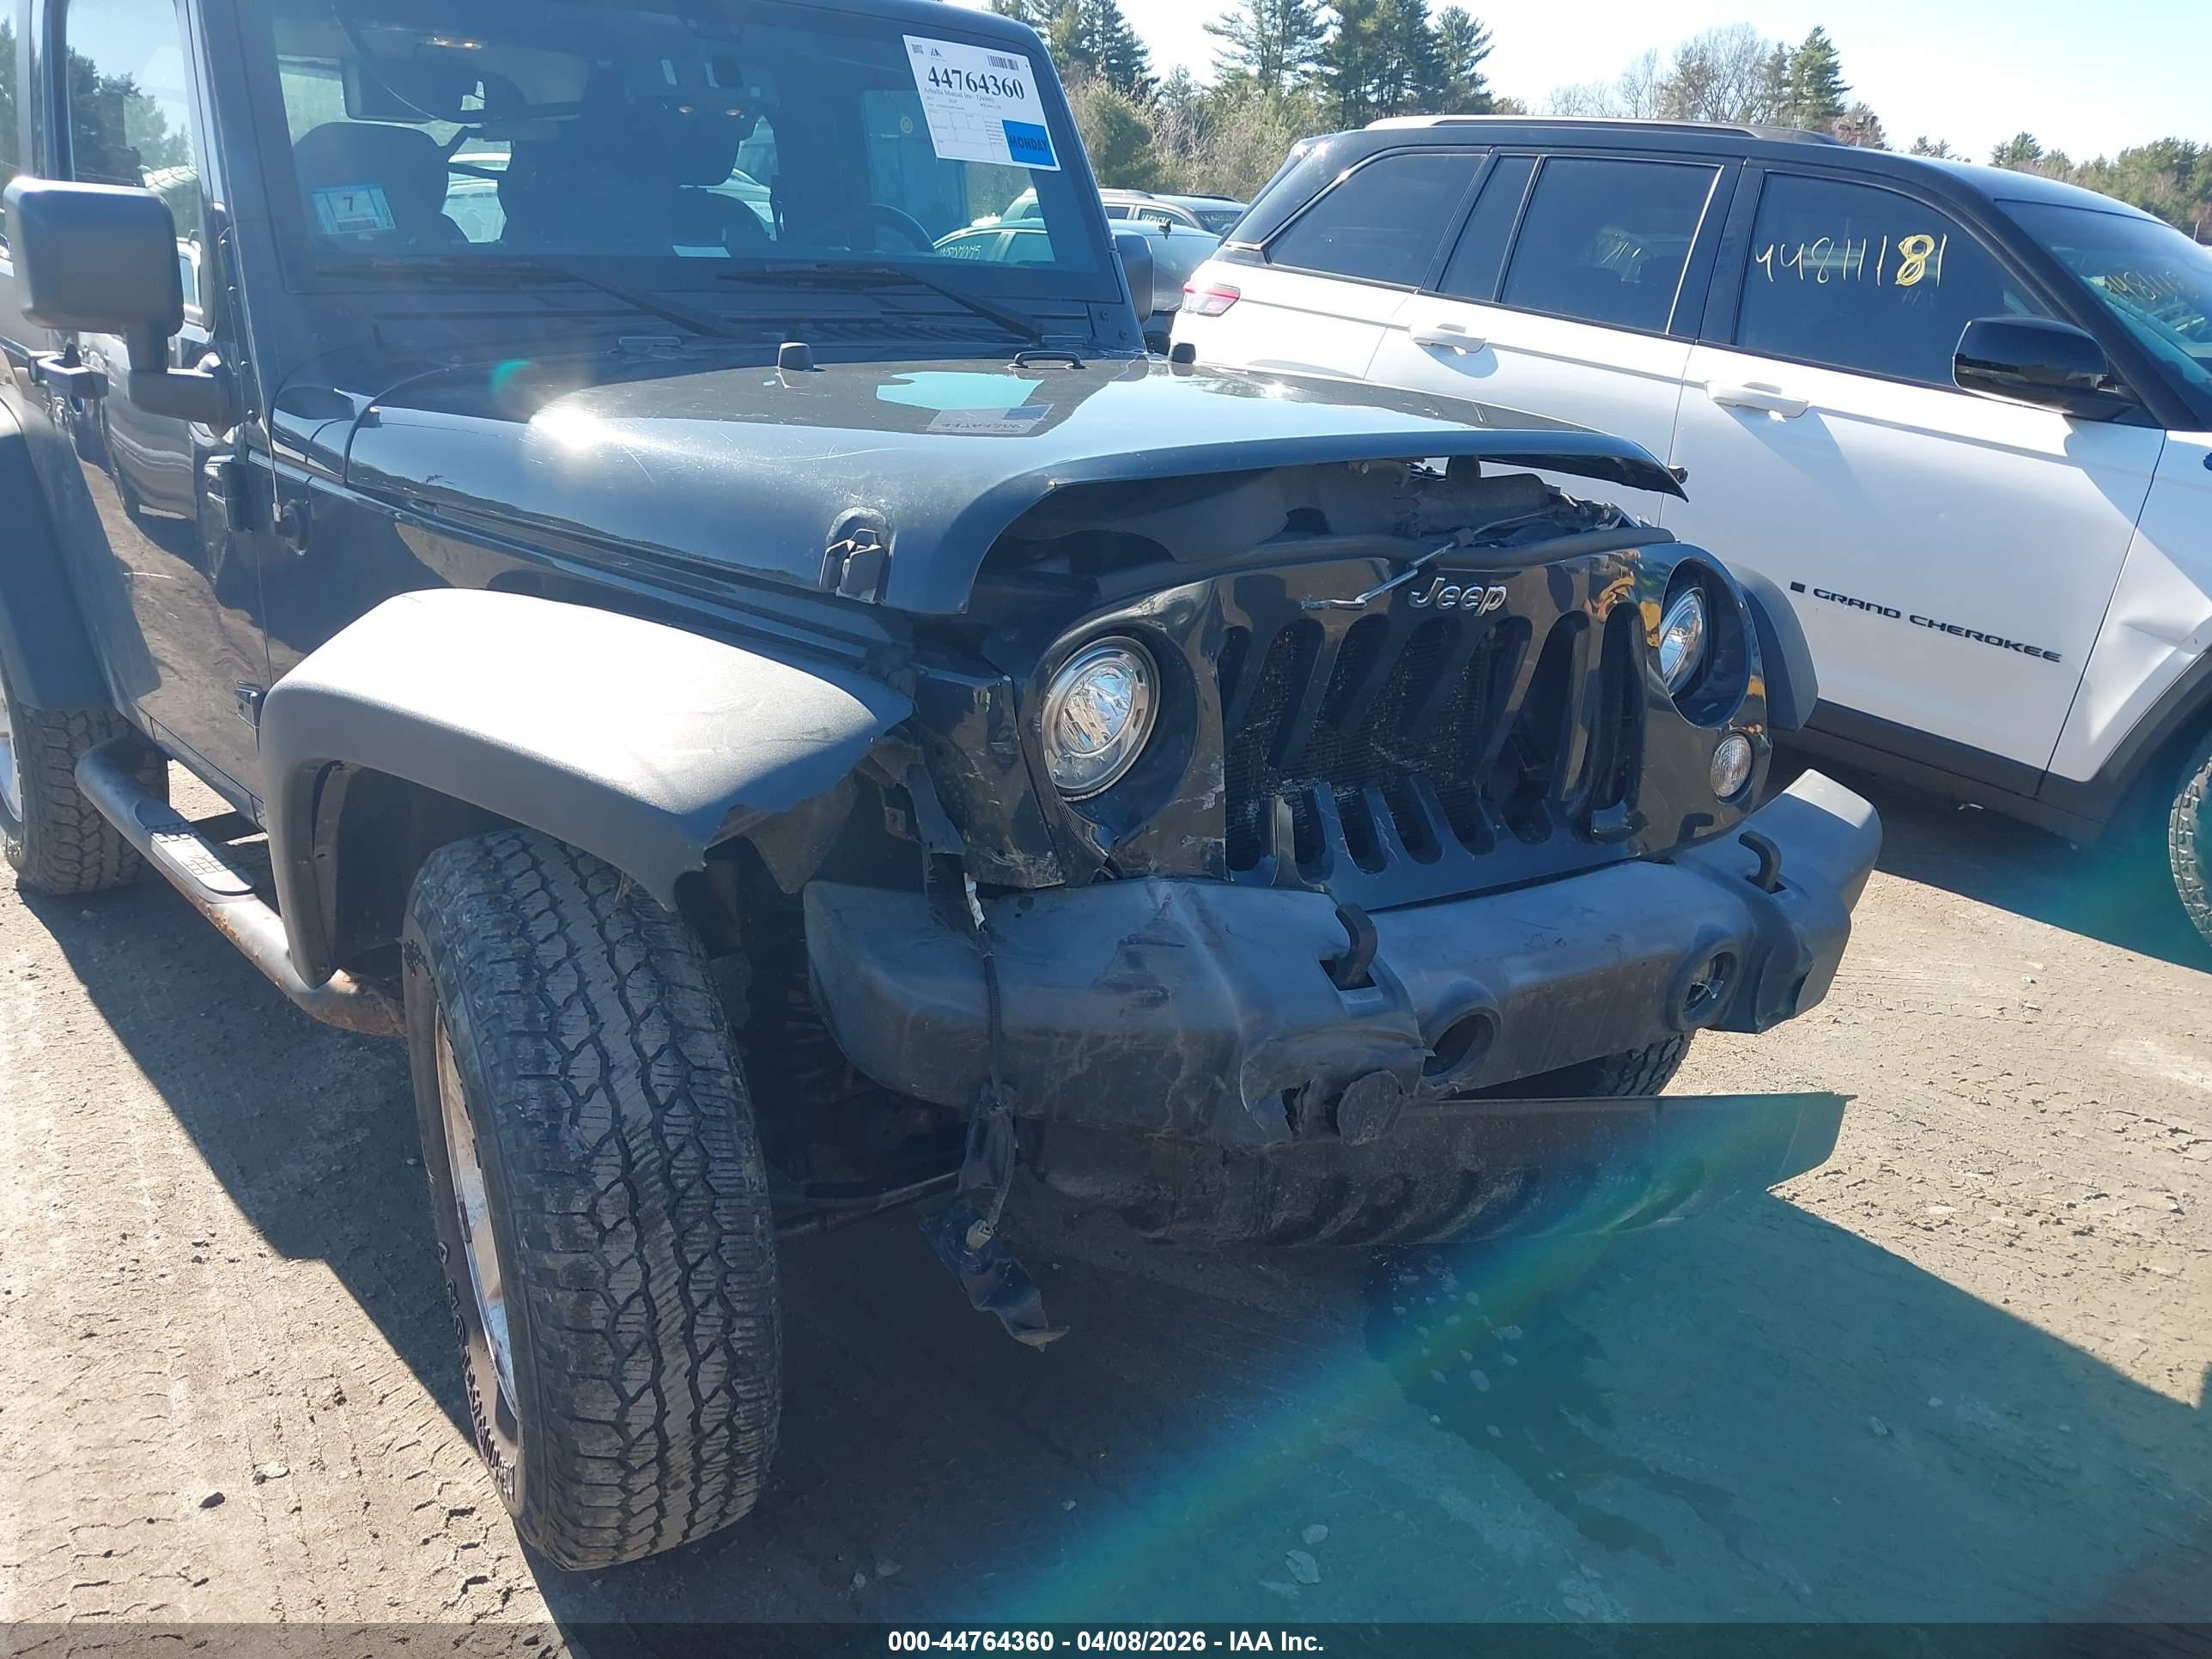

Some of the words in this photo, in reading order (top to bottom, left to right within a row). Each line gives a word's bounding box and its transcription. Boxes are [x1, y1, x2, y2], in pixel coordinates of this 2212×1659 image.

[928, 66, 1024, 100] 44764360
[1008, 134, 1048, 152] MONDAY
[343, 196, 354, 211] 7
[1755, 234, 1948, 288] 44811181
[1408, 577, 1507, 617] Jeep
[1813, 587, 1901, 619] GRAND
[1909, 614, 2062, 663] CHEROKEE
